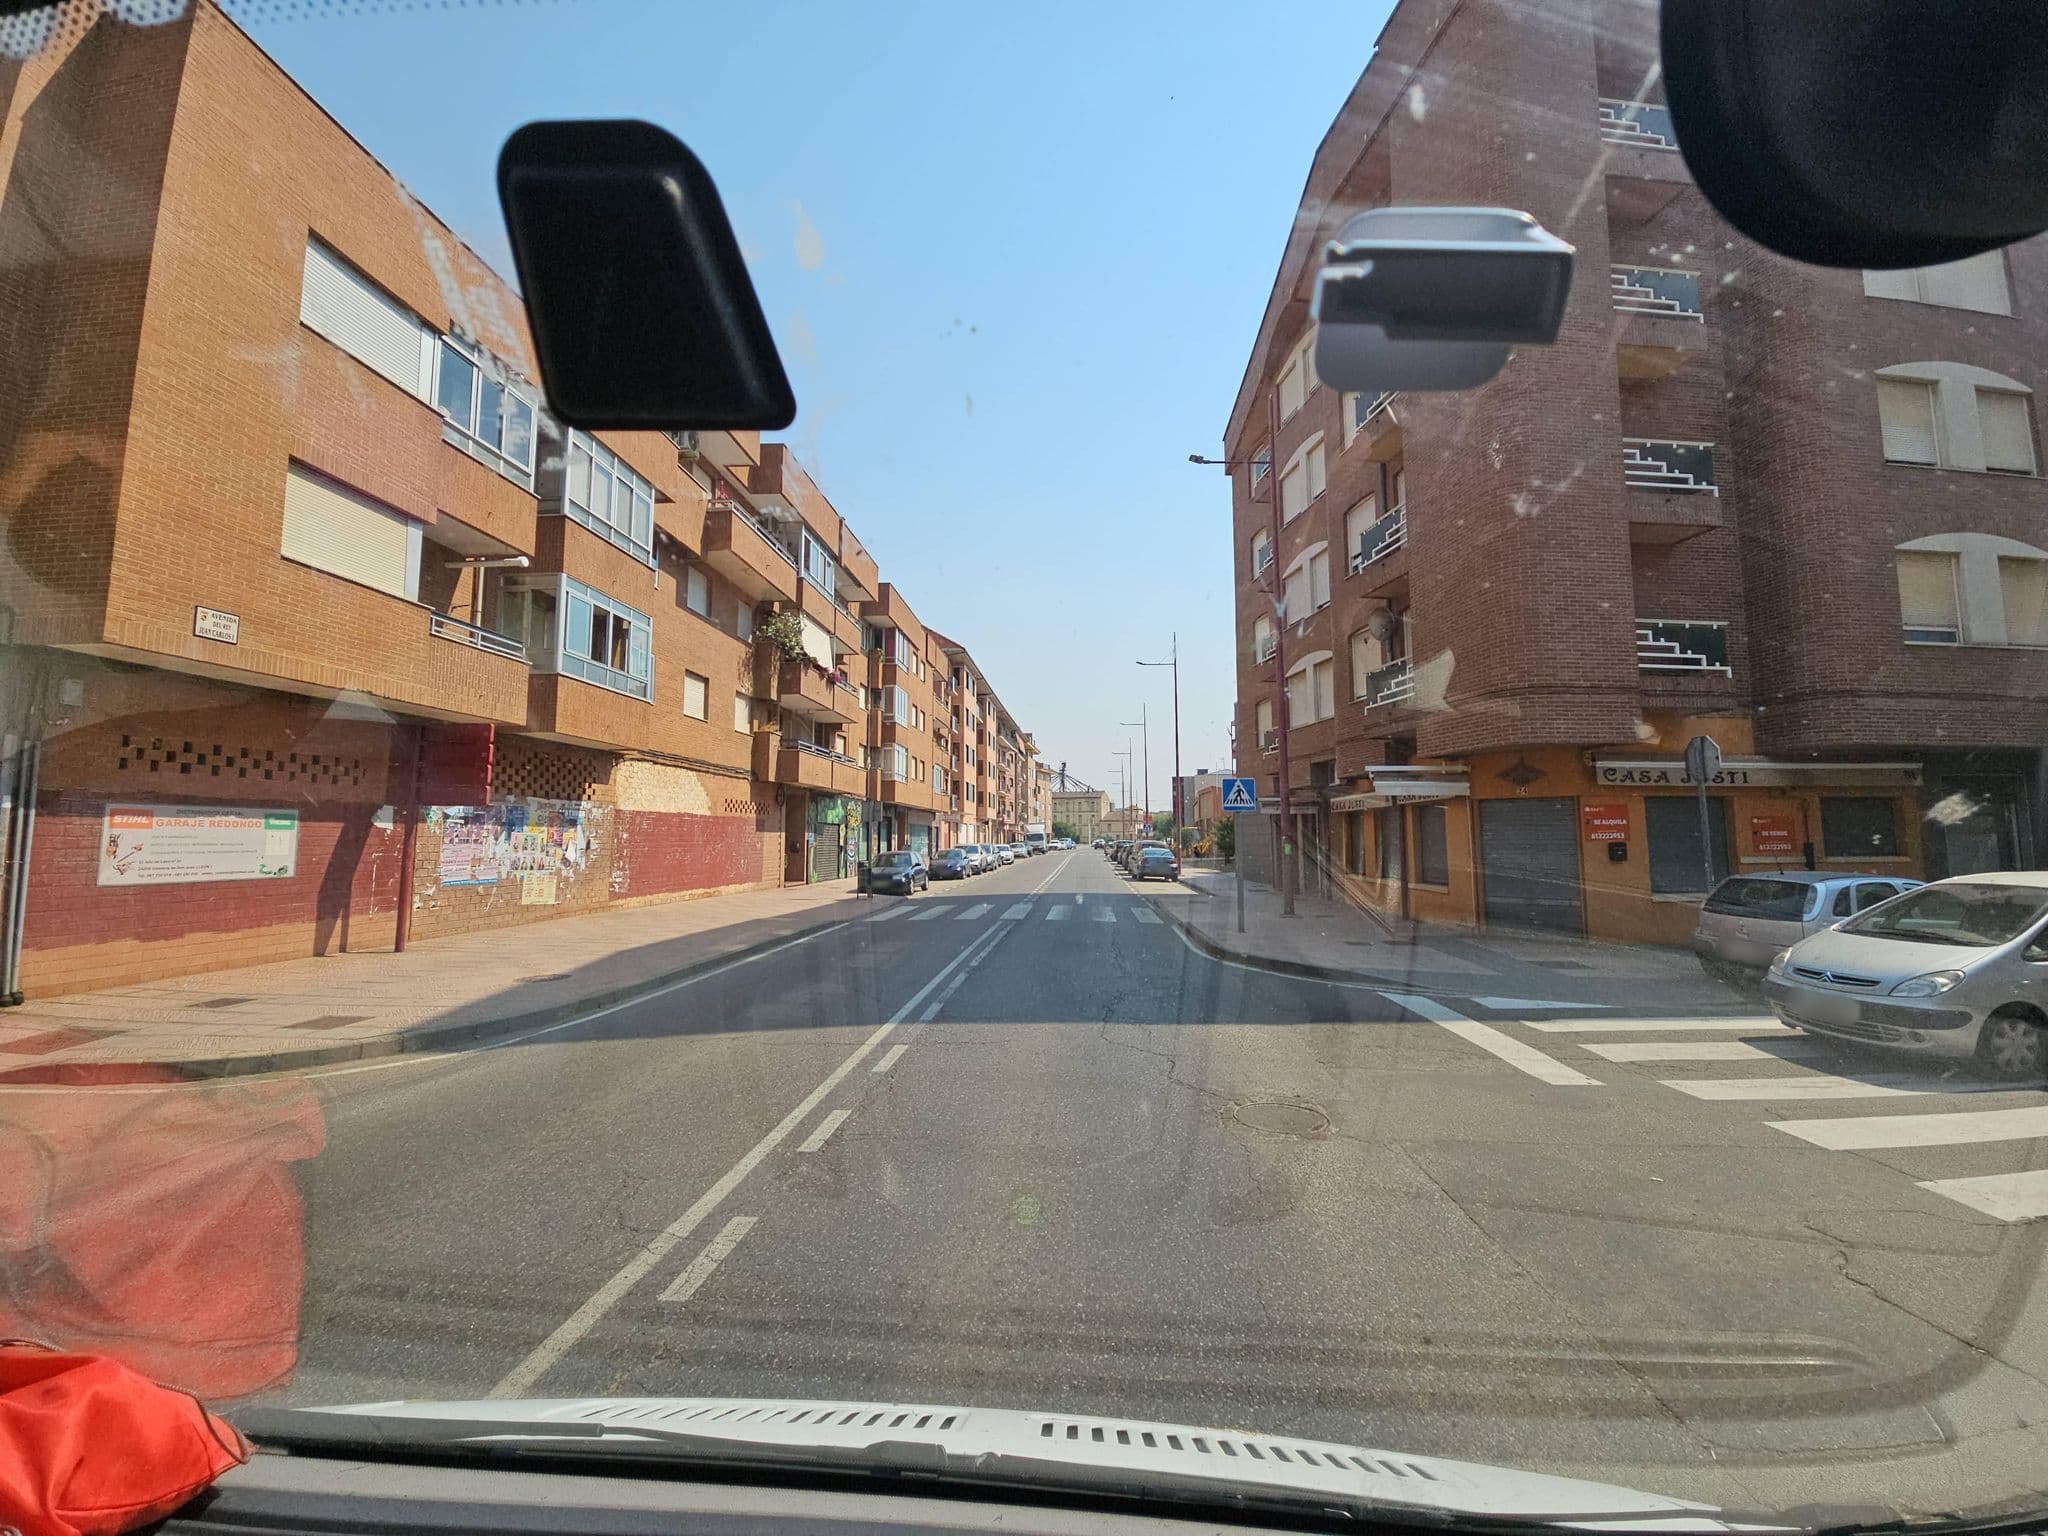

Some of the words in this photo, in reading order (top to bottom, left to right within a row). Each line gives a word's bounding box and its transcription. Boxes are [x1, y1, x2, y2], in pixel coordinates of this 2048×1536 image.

[211, 612, 237, 624] AVENIDA
[198, 627, 211, 635] JUAN
[1603, 768, 1670, 783] CASA
[1681, 771, 1749, 784] JSTI
[112, 815, 149, 823] STIHL
[1602, 818, 1627, 826] ALQUILA
[156, 819, 205, 828] GARAJE
[208, 819, 262, 828] REDONDO
